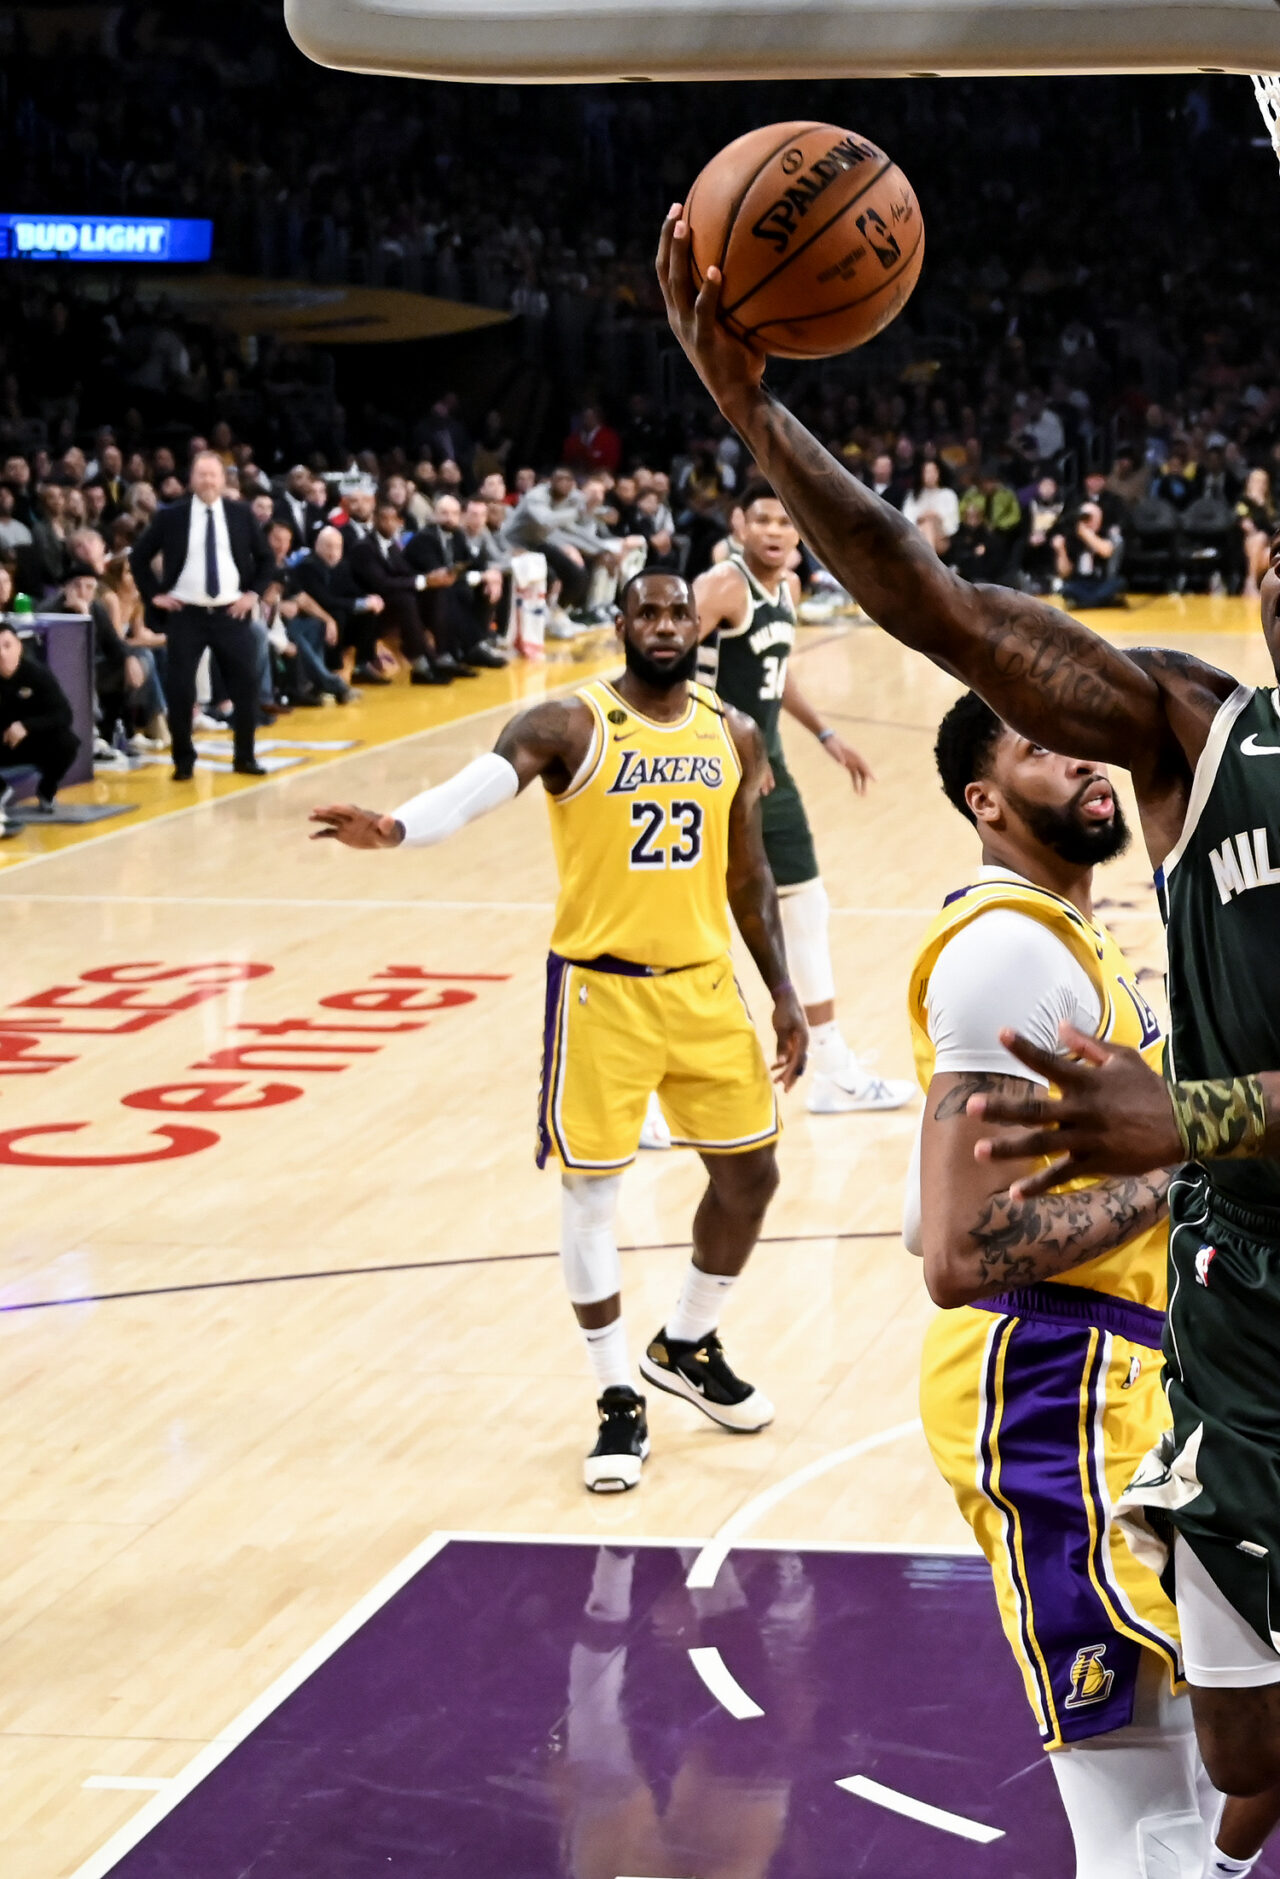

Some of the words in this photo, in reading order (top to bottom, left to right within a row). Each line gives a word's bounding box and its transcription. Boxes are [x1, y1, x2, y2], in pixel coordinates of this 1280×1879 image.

[16, 222, 78, 251] BUD
[80, 224, 164, 253] LIGHT
[606, 751, 723, 795] LAKERS
[629, 799, 703, 871] 23
[0, 965, 513, 1167] Center
